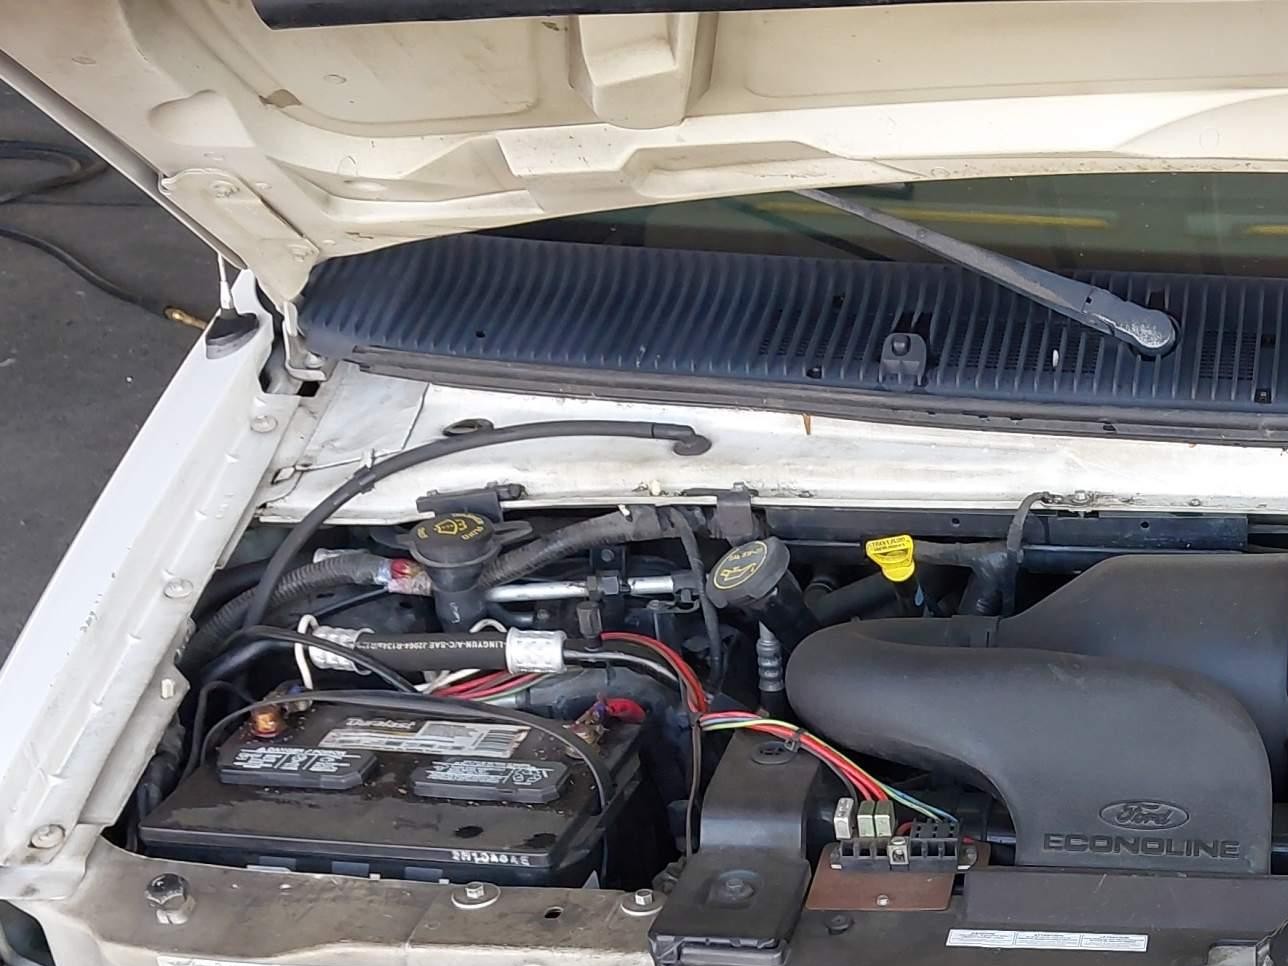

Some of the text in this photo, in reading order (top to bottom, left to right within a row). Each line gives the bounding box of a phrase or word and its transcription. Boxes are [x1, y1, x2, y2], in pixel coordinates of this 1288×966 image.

[345, 717, 417, 730] Duralast
[1116, 804, 1175, 827] Ford
[1043, 832, 1241, 859] ECONOLINE
